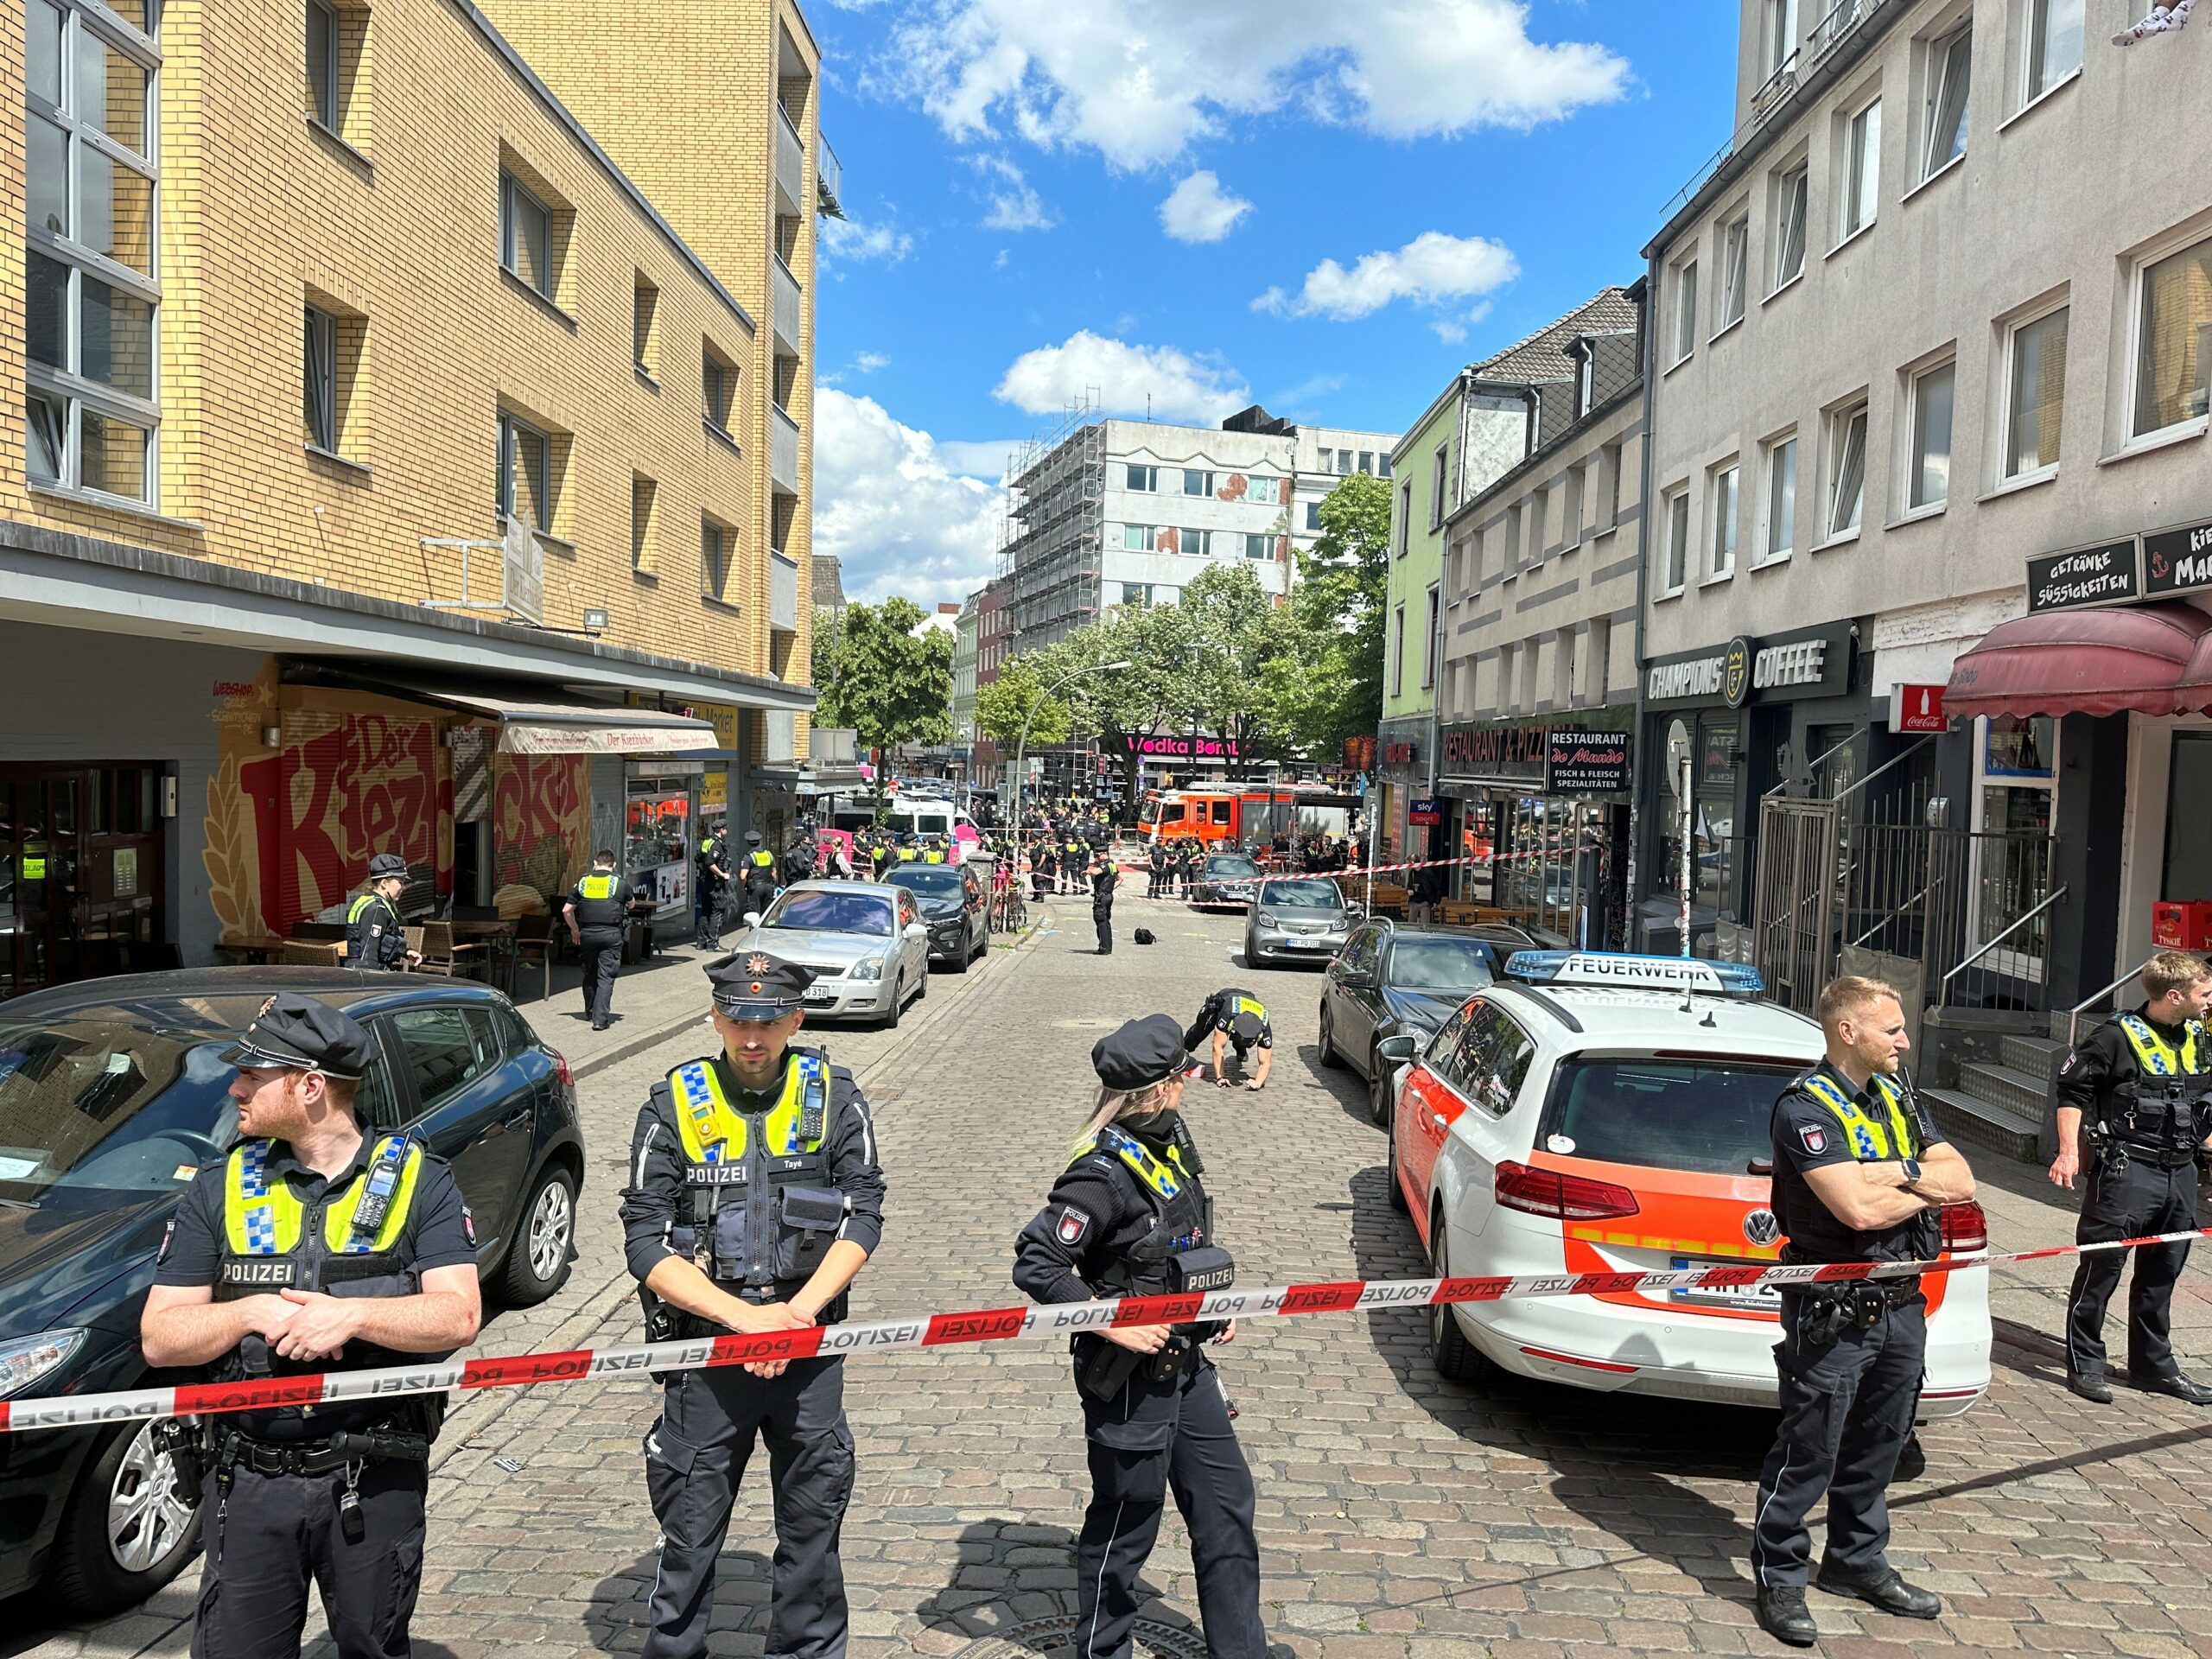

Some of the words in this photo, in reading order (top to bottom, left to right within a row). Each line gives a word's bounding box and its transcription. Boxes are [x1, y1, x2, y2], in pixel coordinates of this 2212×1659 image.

[2050, 551, 2111, 579] GETRÄNKE
[1753, 639, 1827, 689] COFFEE
[1649, 656, 1725, 700] CHAMPIONS
[359, 715, 412, 772] Der
[607, 733, 620, 746] Der
[1128, 736, 1189, 754] Vodka
[1444, 728, 1503, 761] RESTAURANT
[1505, 728, 1514, 760] &
[1552, 733, 1626, 745] RESTAURANT
[1551, 747, 1567, 764] do
[1567, 747, 1624, 766] Mundo
[1554, 769, 1578, 778] FISCH
[1587, 770, 1620, 779] FLEISCH
[1557, 779, 1618, 788] SPEZIALITÄTEN
[1417, 802, 1433, 813] sky
[586, 883, 607, 892] POLIZEI
[2158, 934, 2182, 948] TYSKIE
[1569, 957, 1710, 981] FEUERWEHR
[784, 1160, 803, 1169] Tayé
[686, 1166, 747, 1183] POLIZEI
[1065, 1208, 1088, 1224] POLIZEI
[224, 1263, 292, 1282] POLIZEI
[1188, 1266, 1233, 1290] POLIZEI
